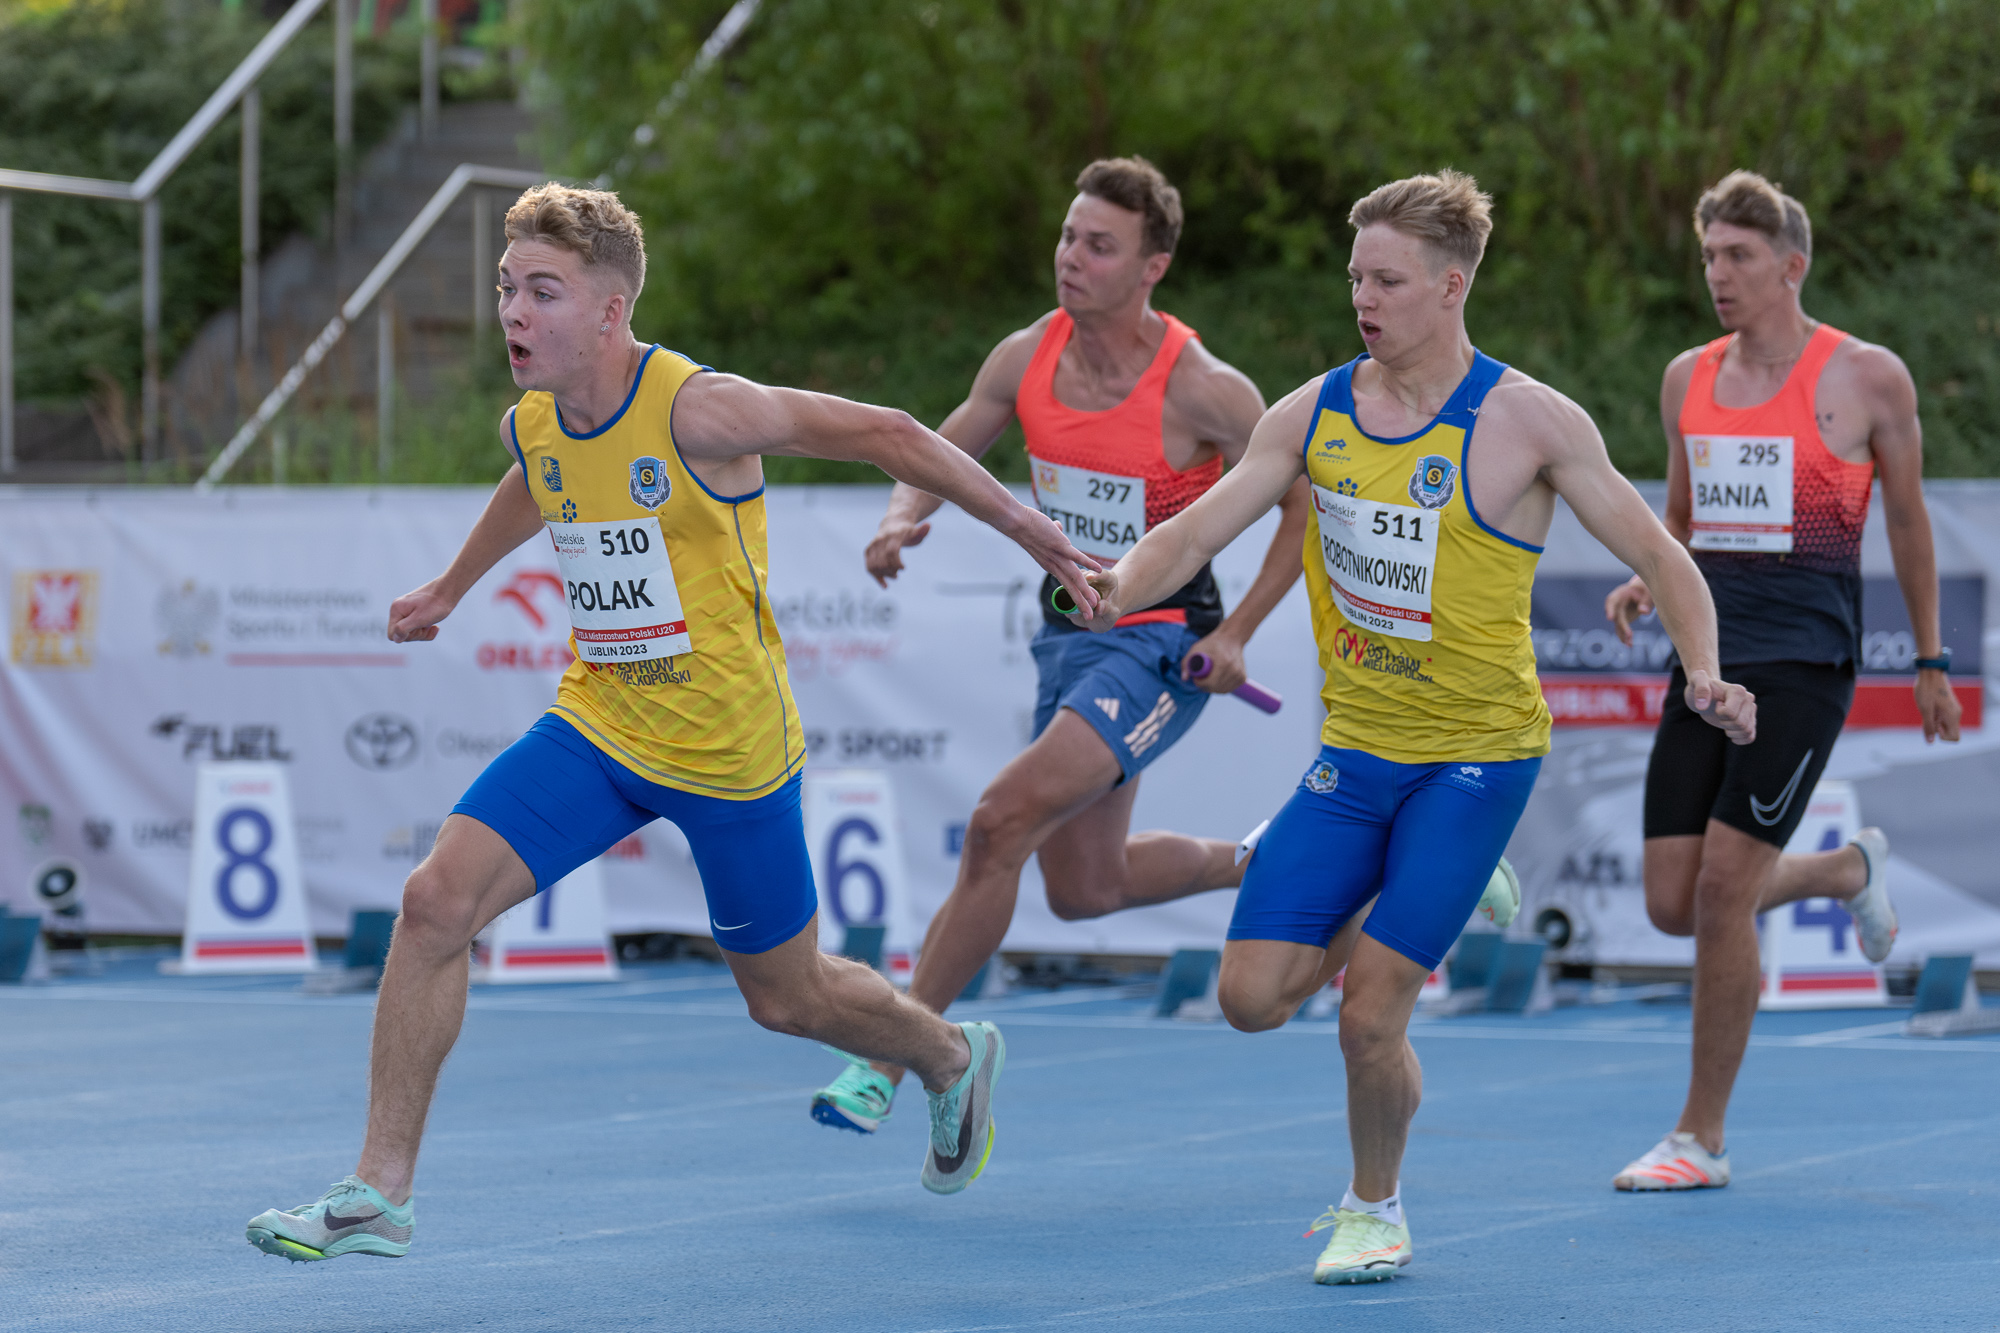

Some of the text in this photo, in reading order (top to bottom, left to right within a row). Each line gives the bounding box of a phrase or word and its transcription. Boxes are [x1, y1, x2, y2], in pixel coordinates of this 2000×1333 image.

[1739, 444, 1780, 466] 295
[1088, 478, 1131, 504] 297
[1697, 484, 1769, 509] BANIA
[1041, 505, 1138, 545] ETRUSA
[1372, 511, 1424, 542] 511
[600, 528, 649, 556] 510
[1323, 534, 1427, 595] ROBOTNIKOWSKI
[568, 578, 655, 612] POLAK
[1343, 602, 1394, 630] LUBLIN 2023
[1381, 606, 1404, 618] Polski
[1406, 612, 1422, 621] U20
[589, 632, 629, 640] Mistrzostwa
[630, 628, 655, 639] Polski
[657, 624, 676, 636] U20
[587, 644, 648, 656] LUBLIN 2023
[217, 806, 279, 921] 8
[825, 815, 886, 927] 6
